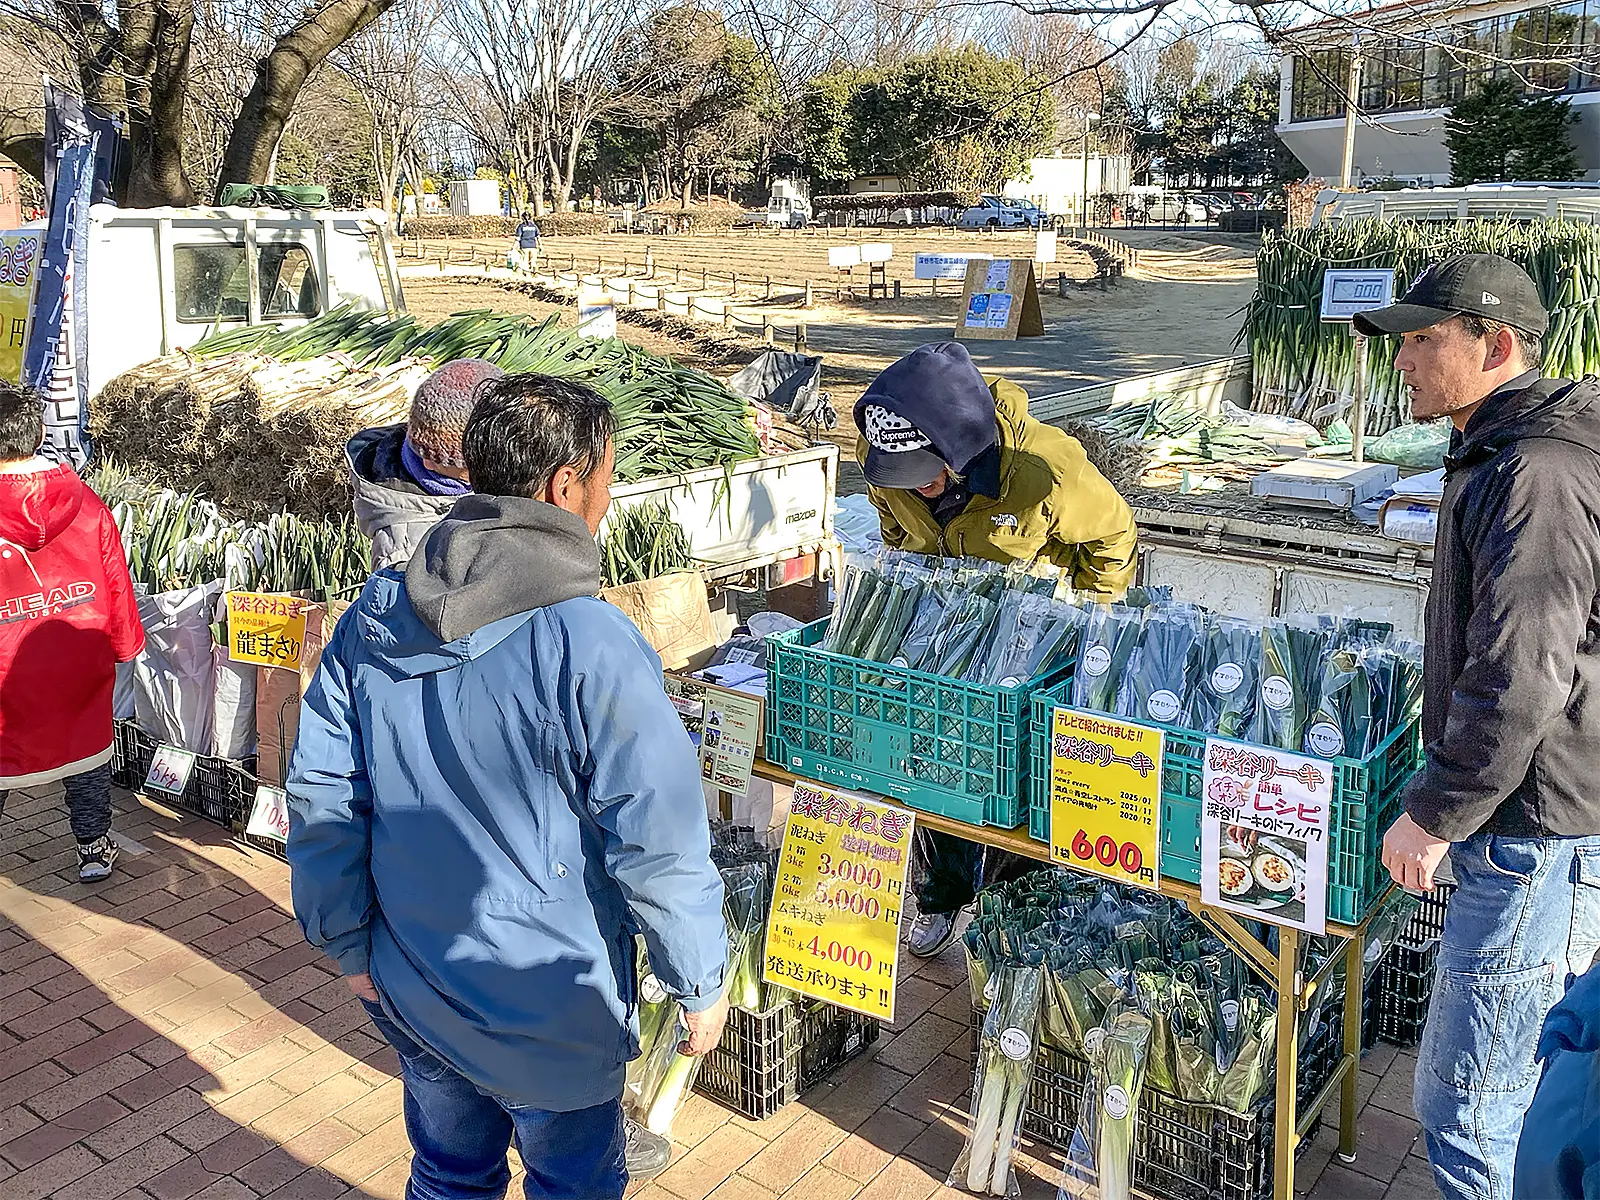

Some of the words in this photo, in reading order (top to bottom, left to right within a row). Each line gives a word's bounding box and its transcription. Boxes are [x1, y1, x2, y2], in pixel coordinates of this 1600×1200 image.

[881, 429, 916, 442] Supreme
[785, 509, 816, 525] mazda
[231, 595, 303, 620] 深谷ねぎ
[236, 630, 301, 663] 龍まさり
[1054, 733, 1155, 778] 深谷リーキ
[151, 758, 179, 789] 5kg
[1209, 744, 1325, 792] 深谷リーキ
[1120, 790, 1152, 805] 2025/01
[1215, 781, 1233, 792] イチ
[1257, 780, 1284, 797] 簡単
[790, 786, 911, 843] 深谷ねぎ
[1119, 811, 1152, 826] 2020/12
[1120, 801, 1152, 816] 2021/11
[1253, 793, 1322, 823] レシピ
[1206, 802, 1322, 842] 深谷リーキのドフィノワ
[790, 823, 827, 845] 泥ねぎ
[785, 853, 804, 868] 3kg
[840, 834, 903, 866] 送料無料
[781, 883, 800, 898] 6kg
[776, 902, 827, 927] ムキねぎ
